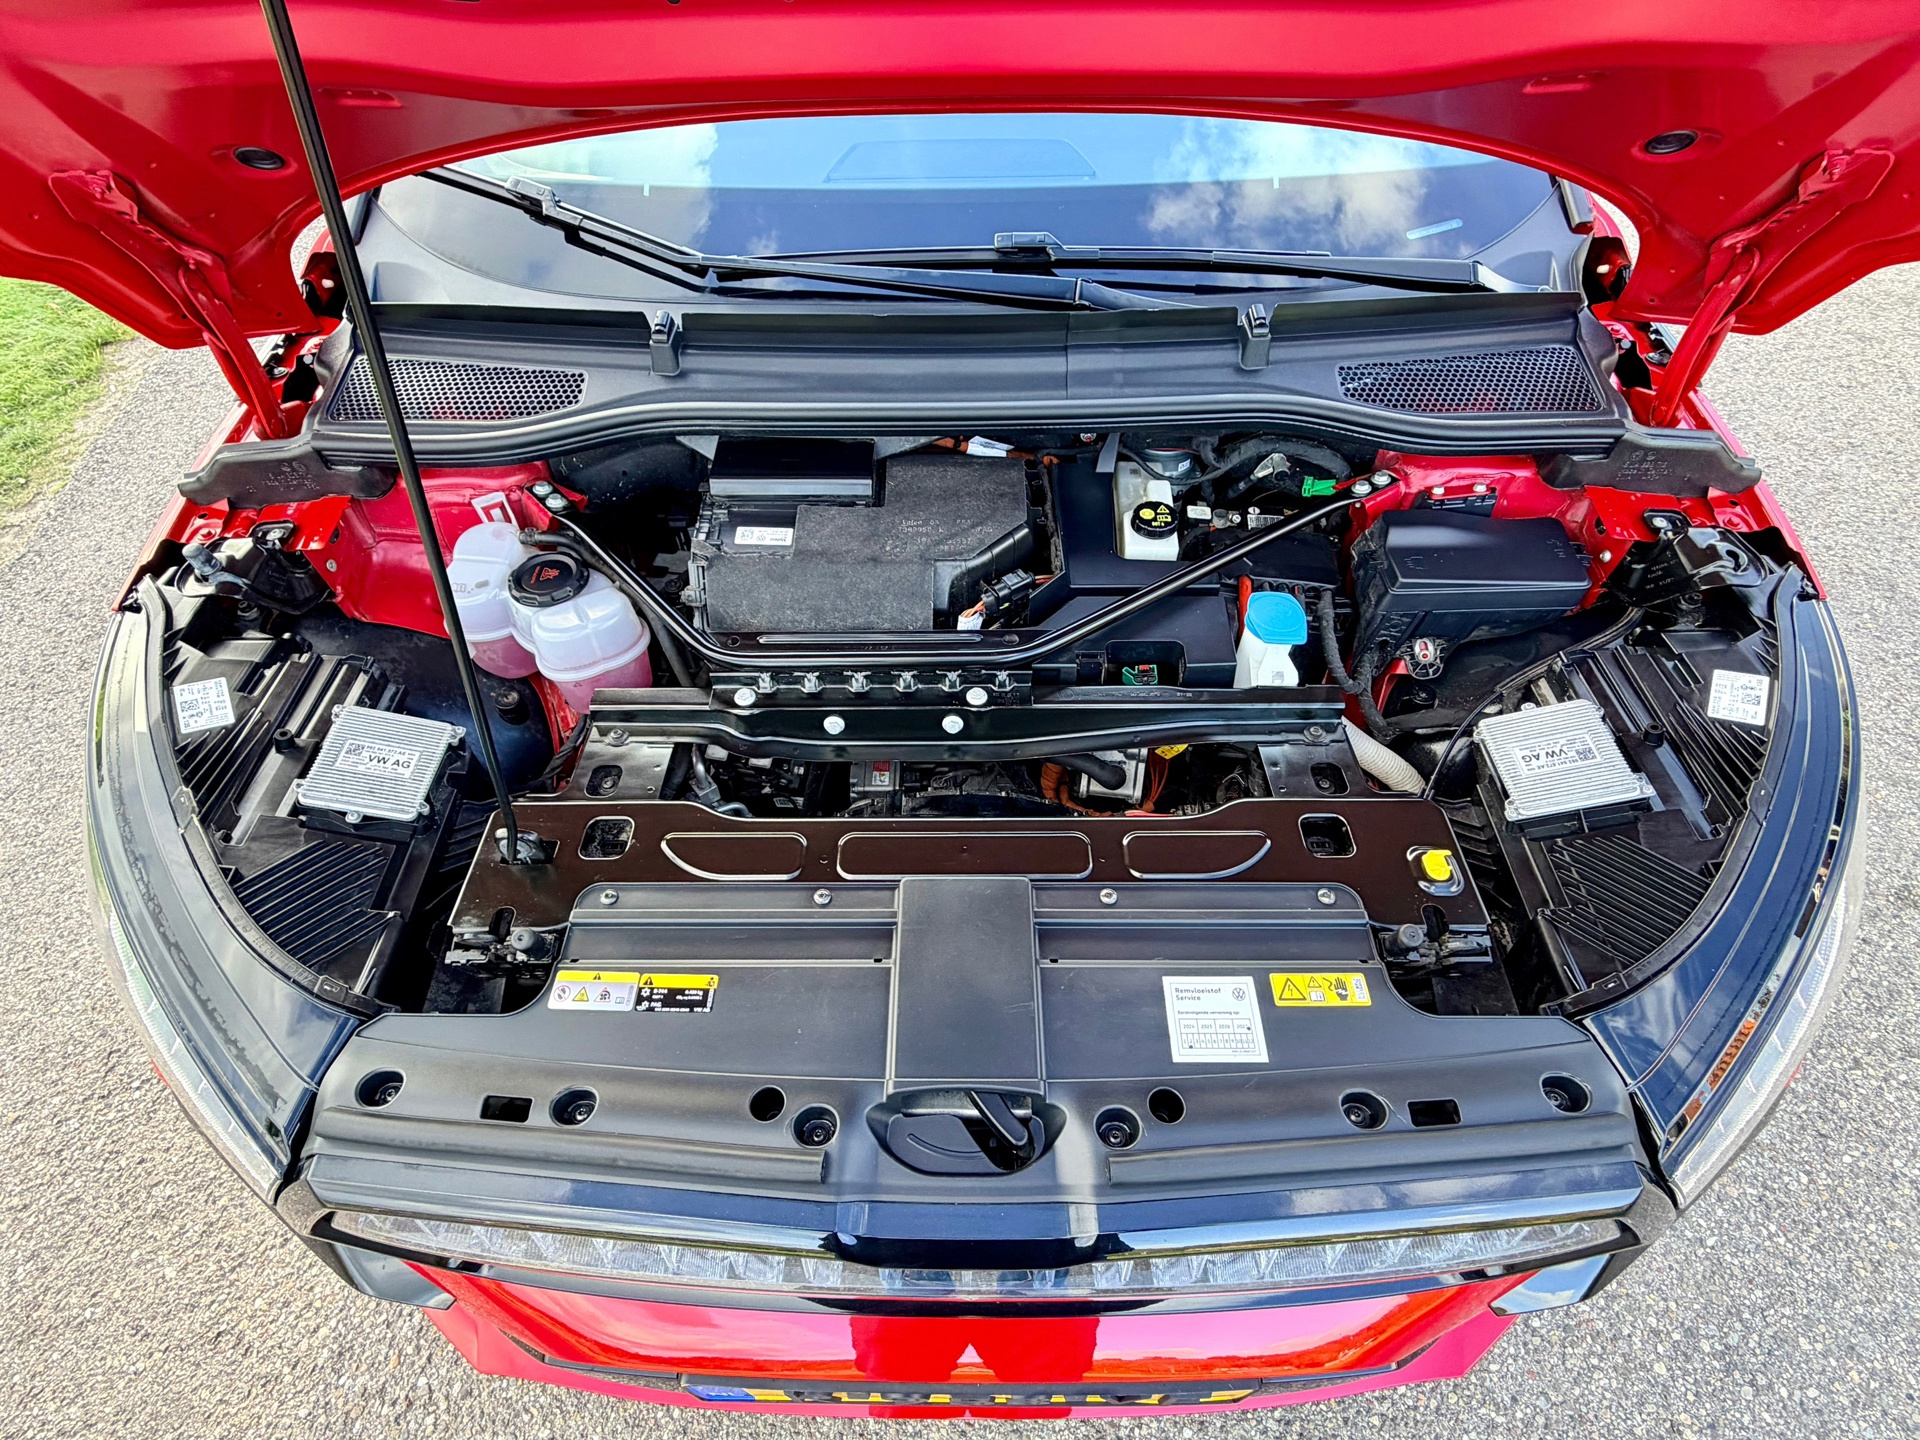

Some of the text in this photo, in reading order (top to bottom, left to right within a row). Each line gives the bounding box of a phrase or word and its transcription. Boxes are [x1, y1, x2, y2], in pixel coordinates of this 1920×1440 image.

[1521, 752, 1540, 763] AG
[1545, 748, 1568, 759] VW
[369, 754, 390, 765] VW
[391, 759, 412, 769] AG
